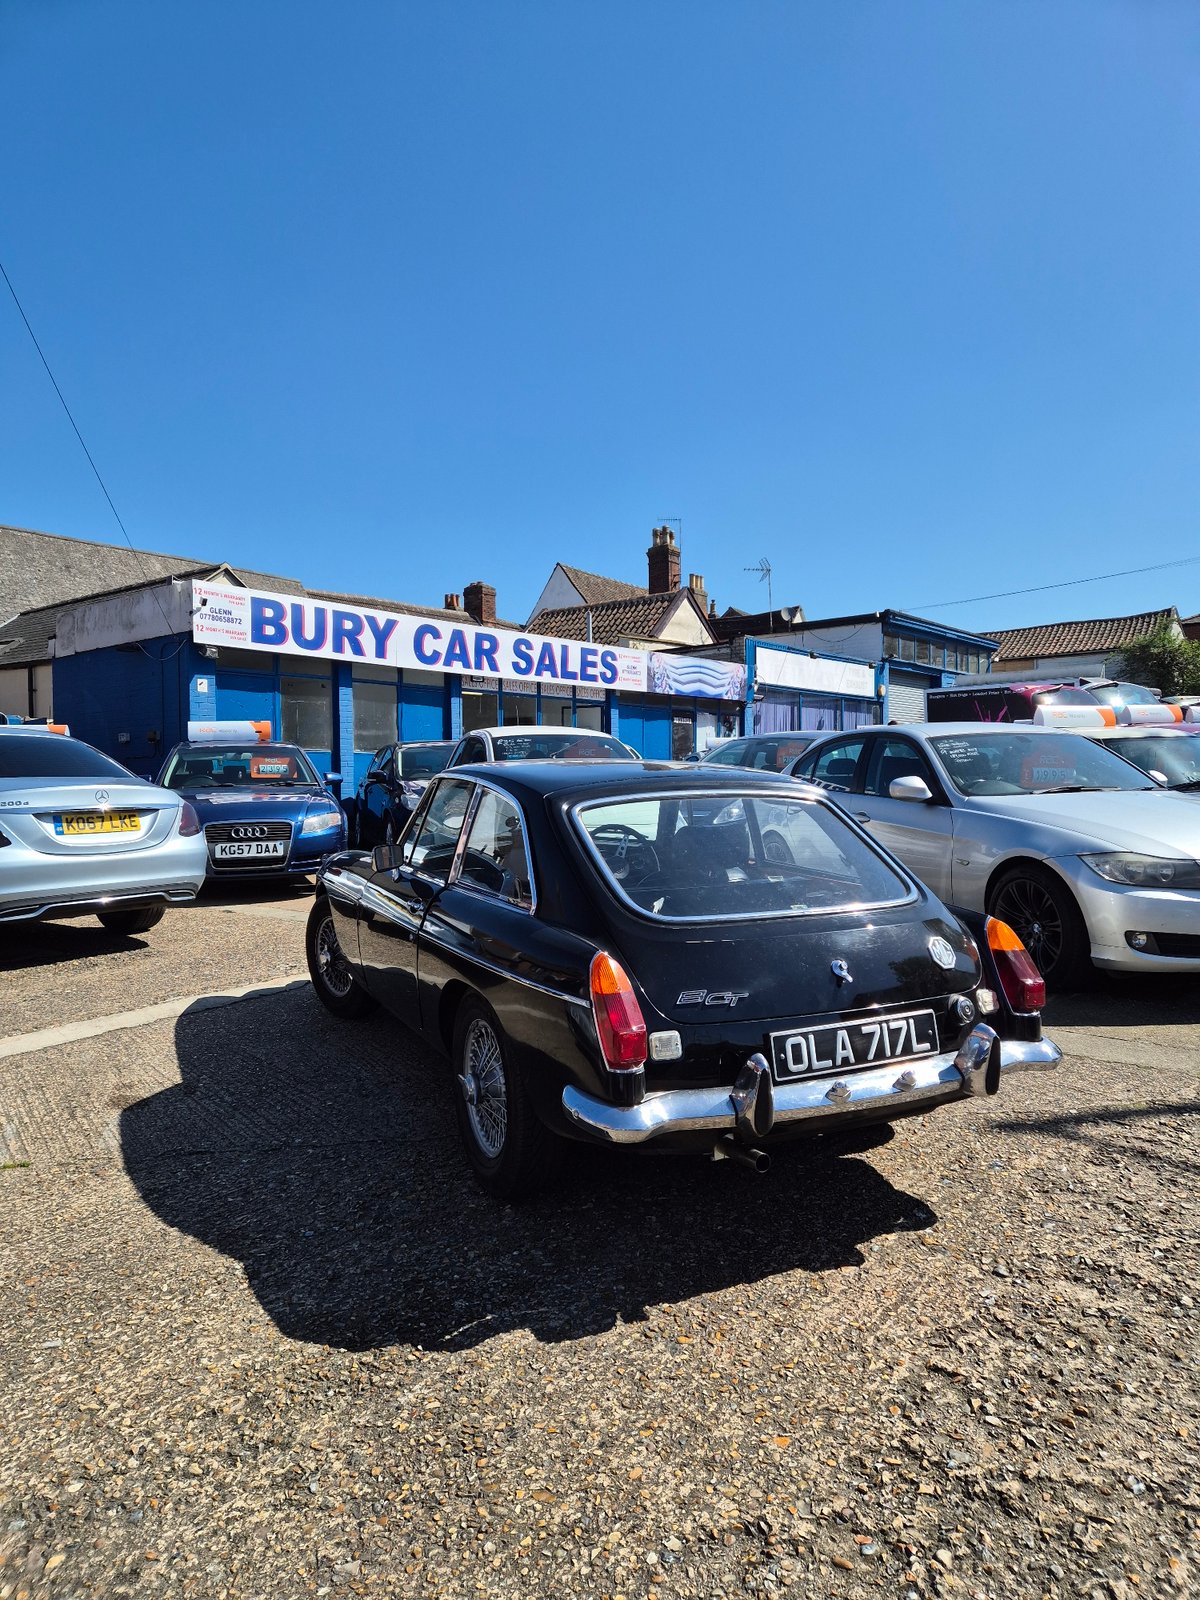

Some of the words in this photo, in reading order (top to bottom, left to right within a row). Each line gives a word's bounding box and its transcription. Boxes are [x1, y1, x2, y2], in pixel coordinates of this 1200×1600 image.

[194, 587, 202, 595] 12
[210, 607, 232, 616] GLENN
[196, 624, 204, 632] 12
[250, 596, 400, 660] BURY
[413, 623, 501, 673] CAR
[511, 637, 619, 685] SALES
[504, 679, 518, 692] SALES
[518, 681, 537, 694] OFFICE
[542, 683, 555, 695] SALES
[555, 684, 573, 697] OFFICE
[589, 688, 605, 699] OFFICE
[65, 815, 105, 831] KO67
[109, 814, 138, 829] LKE
[220, 845, 252, 856] KG57
[256, 843, 279, 854] DAA
[785, 1029, 856, 1073] OLA
[861, 1018, 931, 1061] 717L
